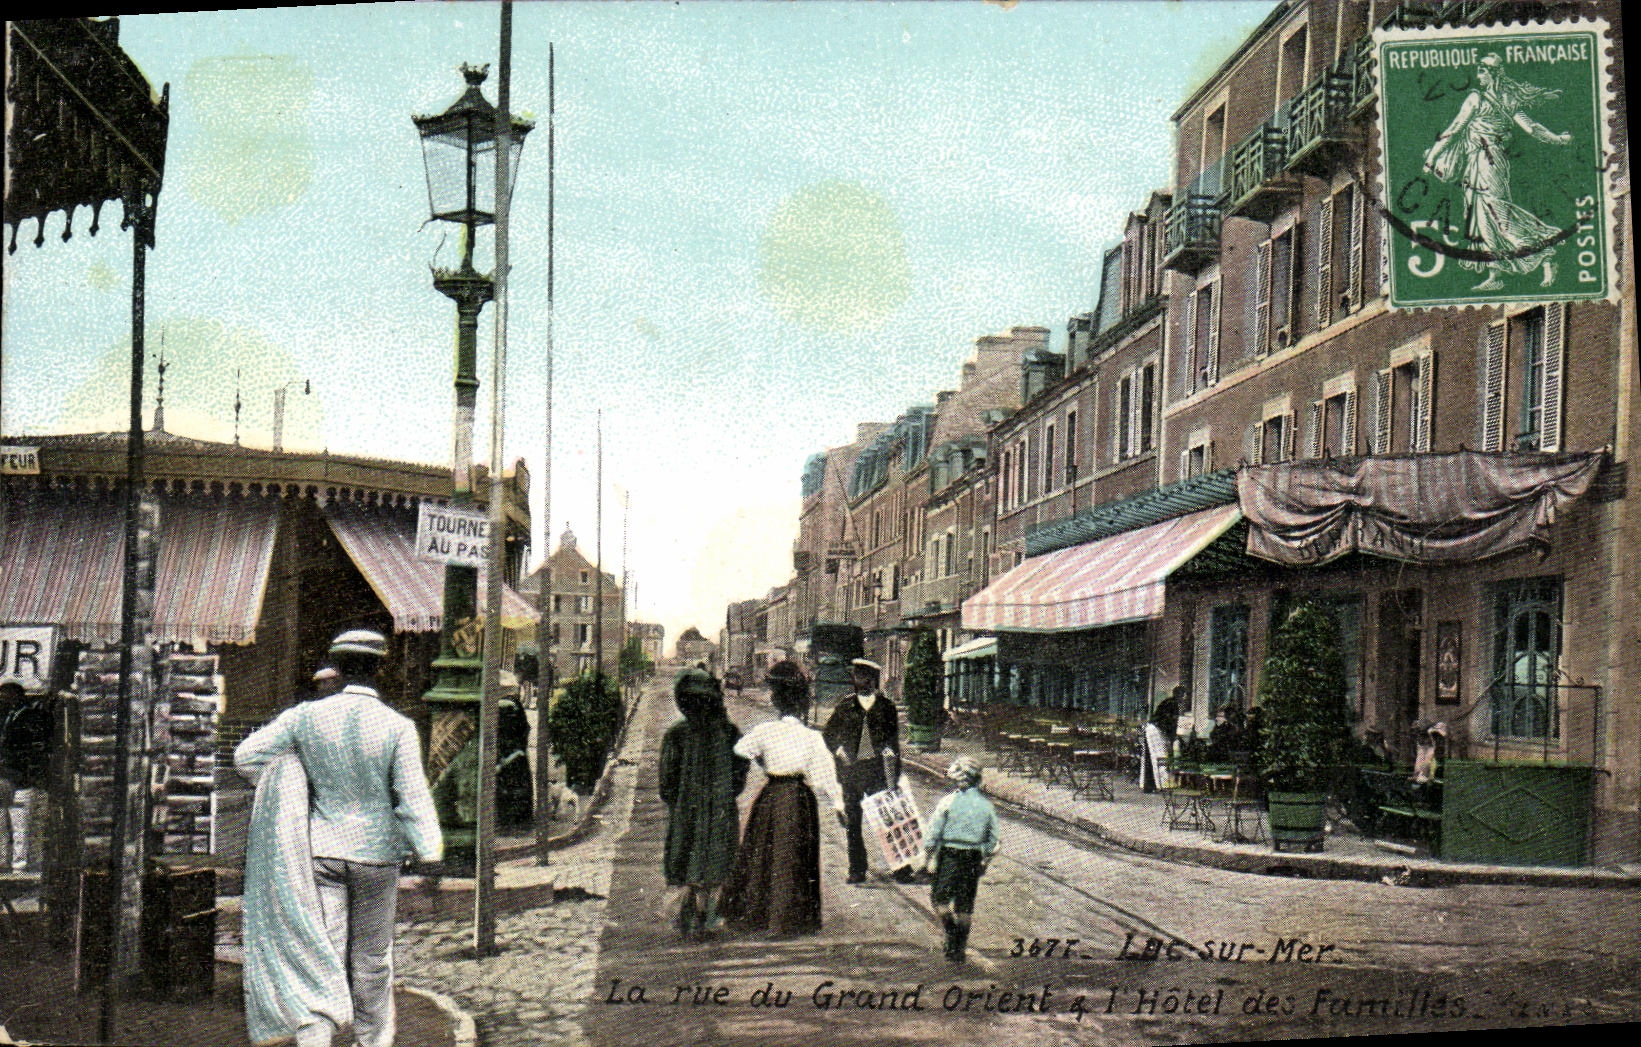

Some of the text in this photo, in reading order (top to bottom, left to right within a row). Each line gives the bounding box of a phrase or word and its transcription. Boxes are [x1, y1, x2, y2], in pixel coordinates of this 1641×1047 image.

[1505, 42, 1589, 66] FRANÇAISE
[1575, 194, 1598, 283] POSTES
[428, 537, 491, 560] AU PAS
